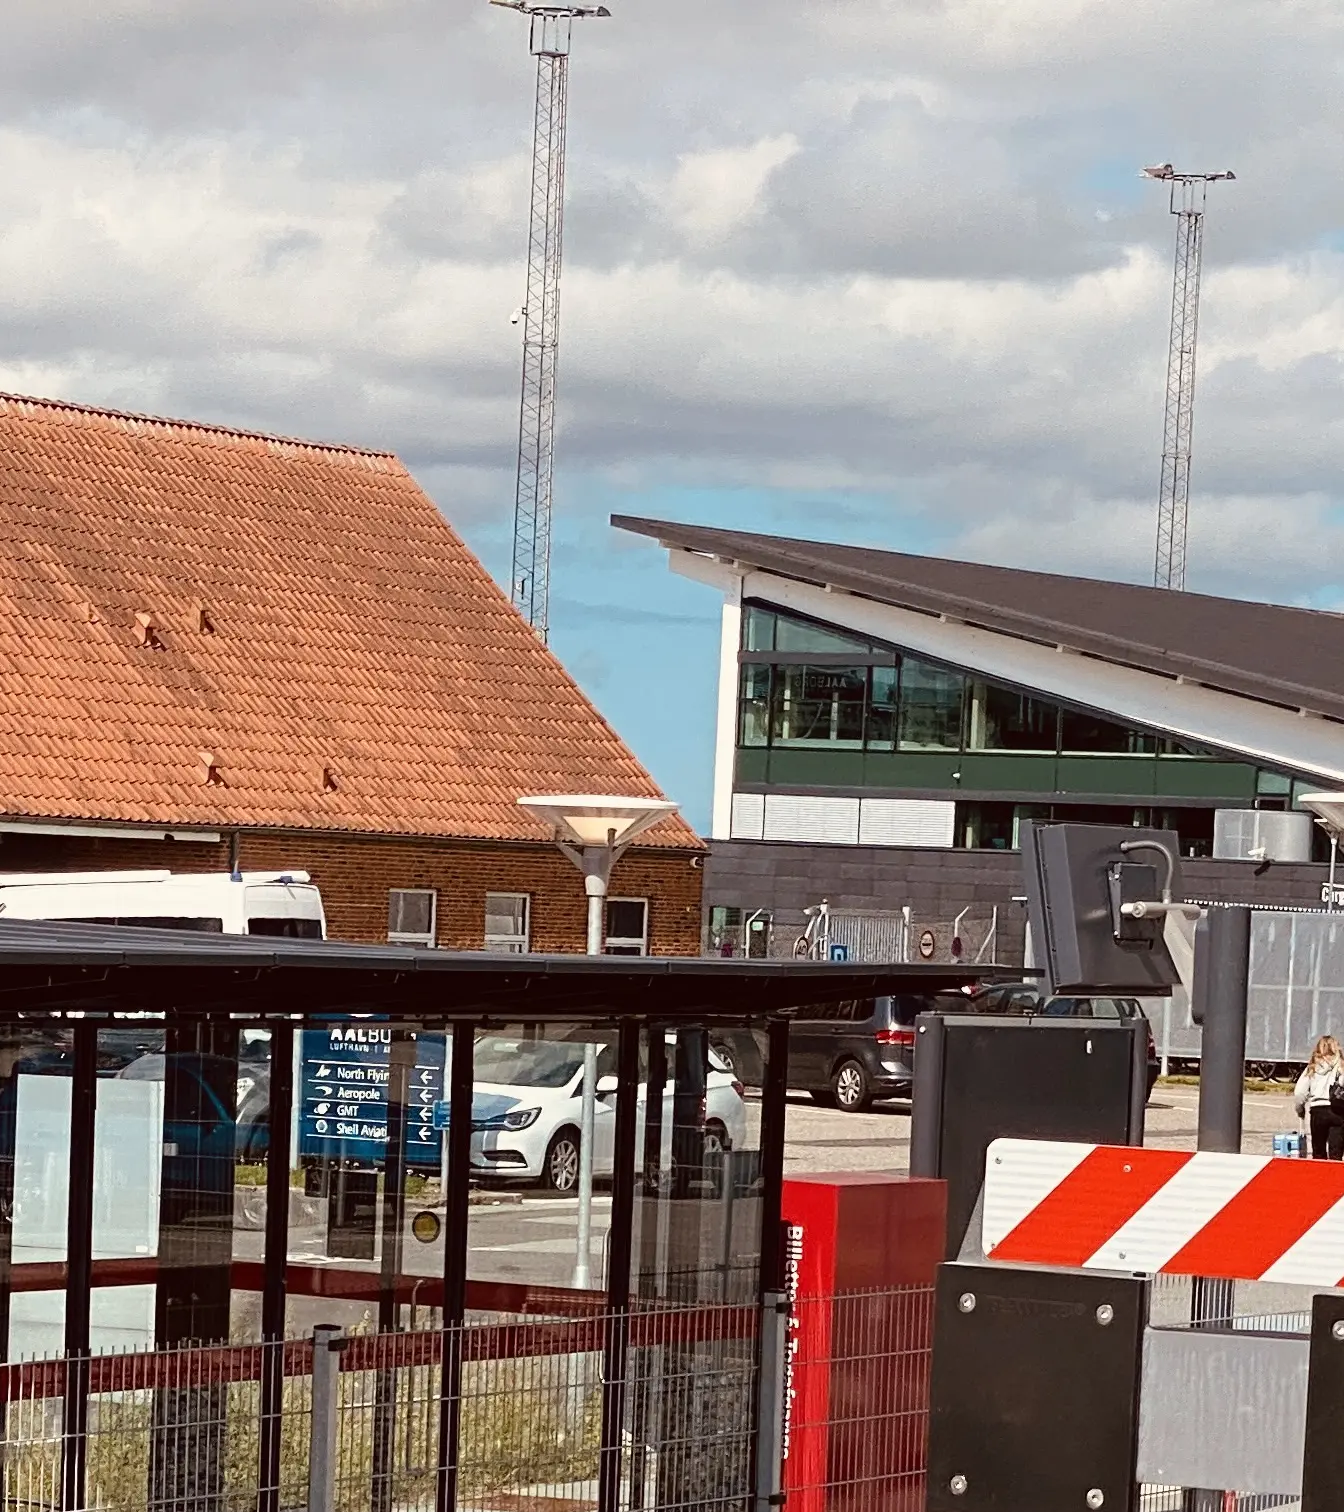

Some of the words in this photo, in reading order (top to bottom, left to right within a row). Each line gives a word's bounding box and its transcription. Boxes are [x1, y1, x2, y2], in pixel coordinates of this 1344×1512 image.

[329, 1042, 369, 1052] LUFTHAVN
[337, 1067, 364, 1080] North
[367, 1069, 390, 1084] Flyin
[337, 1086, 381, 1101] Aeropole
[336, 1105, 359, 1117] GMT
[336, 1124, 359, 1136] Shell
[360, 1125, 388, 1138] Aviati
